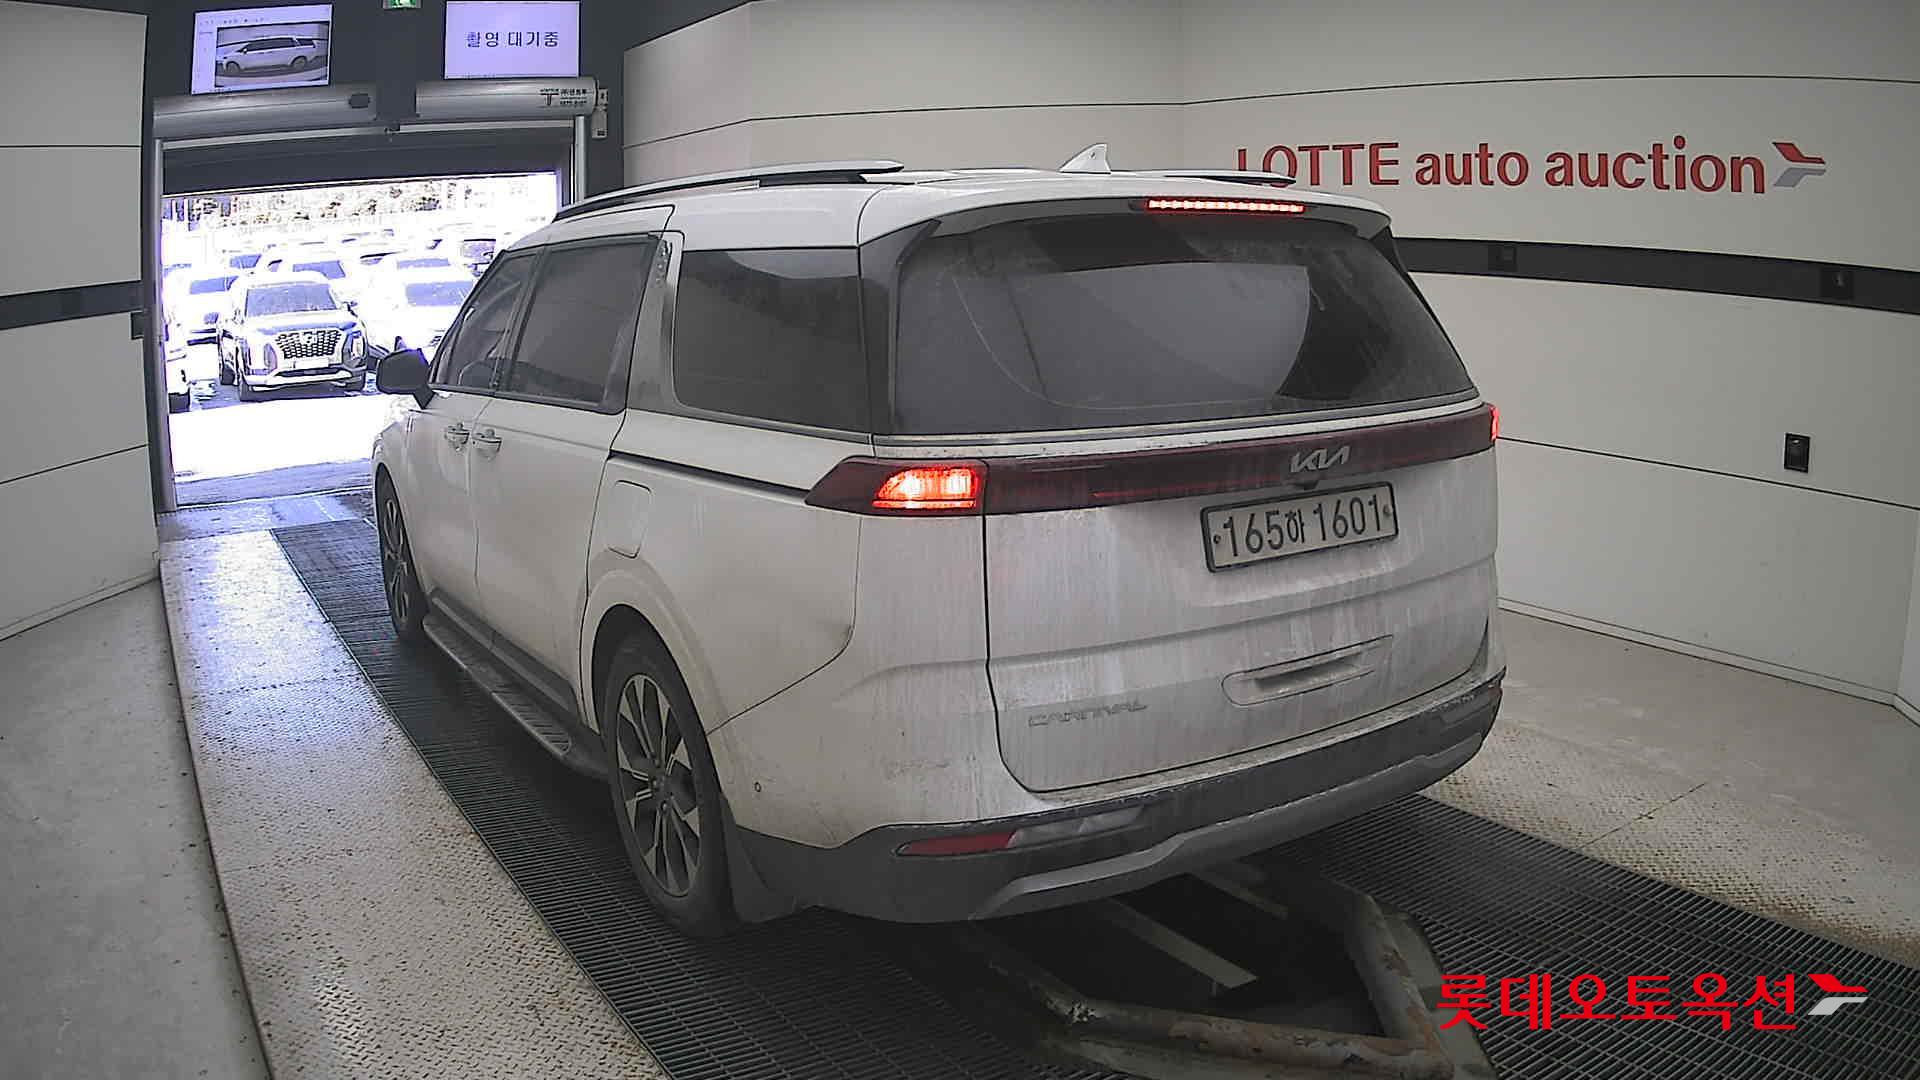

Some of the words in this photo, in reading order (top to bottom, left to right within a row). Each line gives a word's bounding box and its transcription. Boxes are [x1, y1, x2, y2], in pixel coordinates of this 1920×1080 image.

[508, 31, 559, 48] 대기중
[1414, 143, 1530, 187] auto
[1545, 134, 1767, 194] auction
[1290, 446, 1351, 473] KIA
[1223, 508, 1305, 558] 165하
[1312, 493, 1382, 541] 1601
